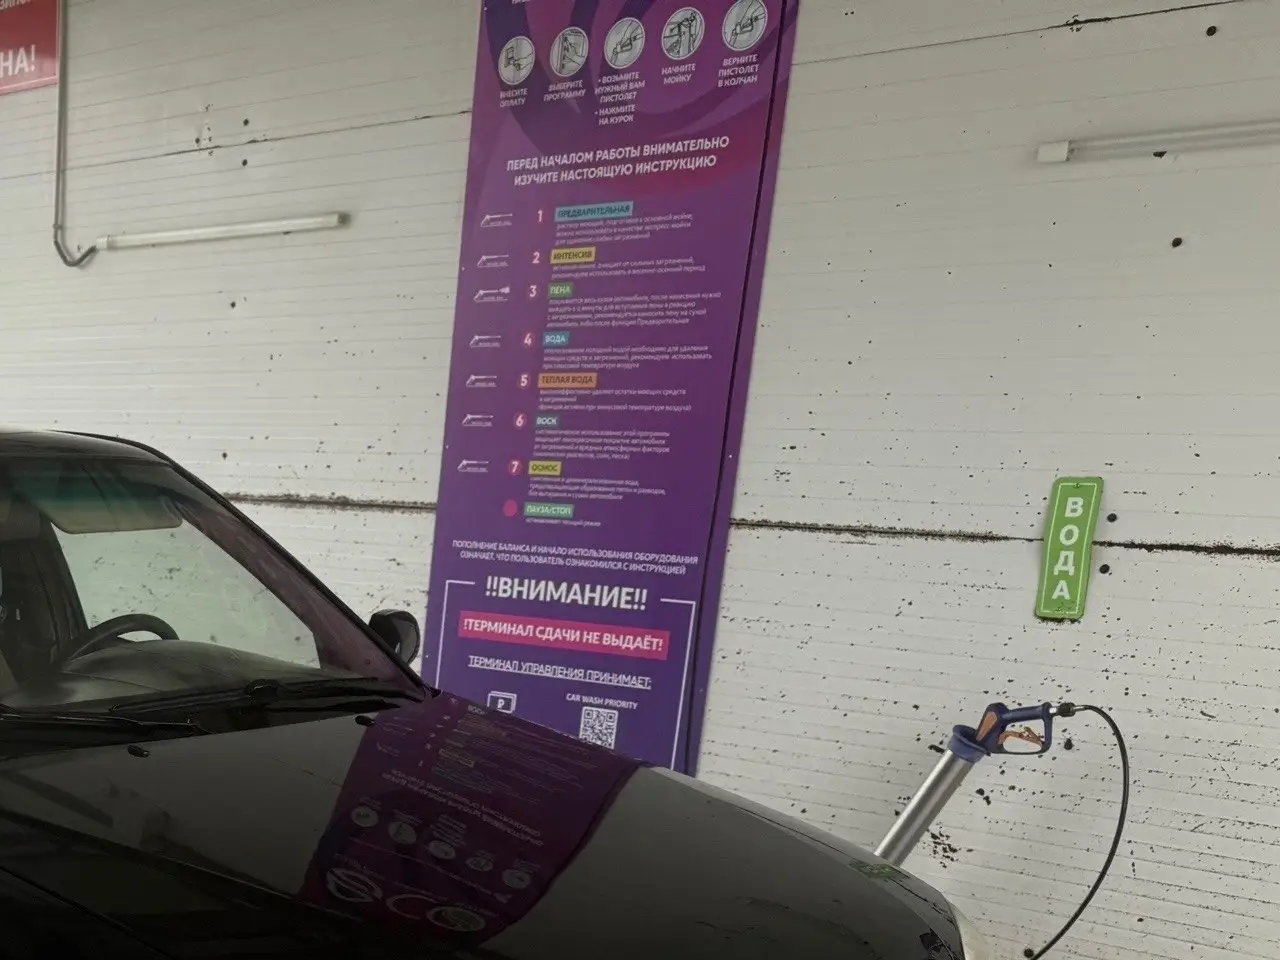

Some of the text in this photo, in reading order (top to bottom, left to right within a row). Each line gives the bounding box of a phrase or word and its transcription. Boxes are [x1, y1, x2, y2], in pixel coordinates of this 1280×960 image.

[723, 54, 758, 67] ВЕРНИТЕ
[661, 63, 696, 75] НАЧНИТЕ
[718, 64, 759, 77] ПИСТОЛЕТ
[602, 72, 639, 83] ВОЗЬМИТЕ
[664, 74, 692, 84] МОЙКУ
[724, 75, 758, 87] КОЛЧАН
[548, 80, 583, 91] ВЫБЕРИТЕ
[594, 81, 645, 95] НУЖНЫЙ ВАМ
[500, 88, 528, 99] ВНЕСИТЕ
[543, 90, 586, 102] ПРОГРАММУ
[600, 92, 637, 103] ПИСТОЛЕТ
[500, 98, 526, 108] ОПЛАТУ
[599, 105, 636, 116] НАЖМИТЕ
[610, 115, 634, 125] КУРОК
[506, 136, 729, 172] ПЕРЕД НАЧАЛОМ РАБОТЫ ВНИМАТЕЛЬНО
[514, 155, 717, 186] ИЗУЧИТЕ НАСТОЯЩУЮ ИНСТРУКЦИЮ
[536, 210, 543, 223] 1
[556, 204, 631, 219] ПРЕДВАРИТЕЛЬНАЯ
[532, 251, 540, 264] 2
[553, 250, 592, 261] ИНТЕНСИВ
[528, 285, 537, 297] 3
[550, 285, 571, 295] ПЕНА
[523, 333, 532, 345] 4
[544, 334, 566, 344] ВОДА
[520, 374, 528, 387] 5
[541, 375, 593, 384] ТЕПЛАЯ ВОДА
[516, 415, 524, 427] 6
[536, 416, 557, 426] ВОСК
[511, 461, 519, 473] 7
[531, 463, 558, 473] ОСМОС
[526, 504, 571, 515] ПАУЗА/СТОП
[452, 539, 497, 550] ПОПОЛНЕНИЕ
[498, 542, 530, 552] БАЛАНСА
[538, 546, 567, 555] НАЧАЛО
[568, 548, 633, 560] ИСПОЛЬЗОВАНИЯ
[634, 552, 698, 564] ОБОРУДОВАНИЯ
[1051, 496, 1084, 600] ВОДА
[496, 553, 509, 561] ЧТО
[511, 554, 564, 565] ПОЛЬЗОВАТЕЛЬ
[565, 558, 622, 570] ОЗНАКОМИЛСЯ
[630, 563, 686, 575] ИНСТРУКЦИЕЙ
[485, 575, 647, 610] !!ВНИМАНИЕ!!
[463, 618, 663, 651] !ТЕРМИНАЛ СДАЧИ НЕ ВЫДАЁТ!
[468, 655, 652, 688] ТЕРМИНАЛ УПРАВЛЕНИЯ ПРИНИМАЕТ:
[566, 693, 638, 710] CAR WASH PRIORITY
